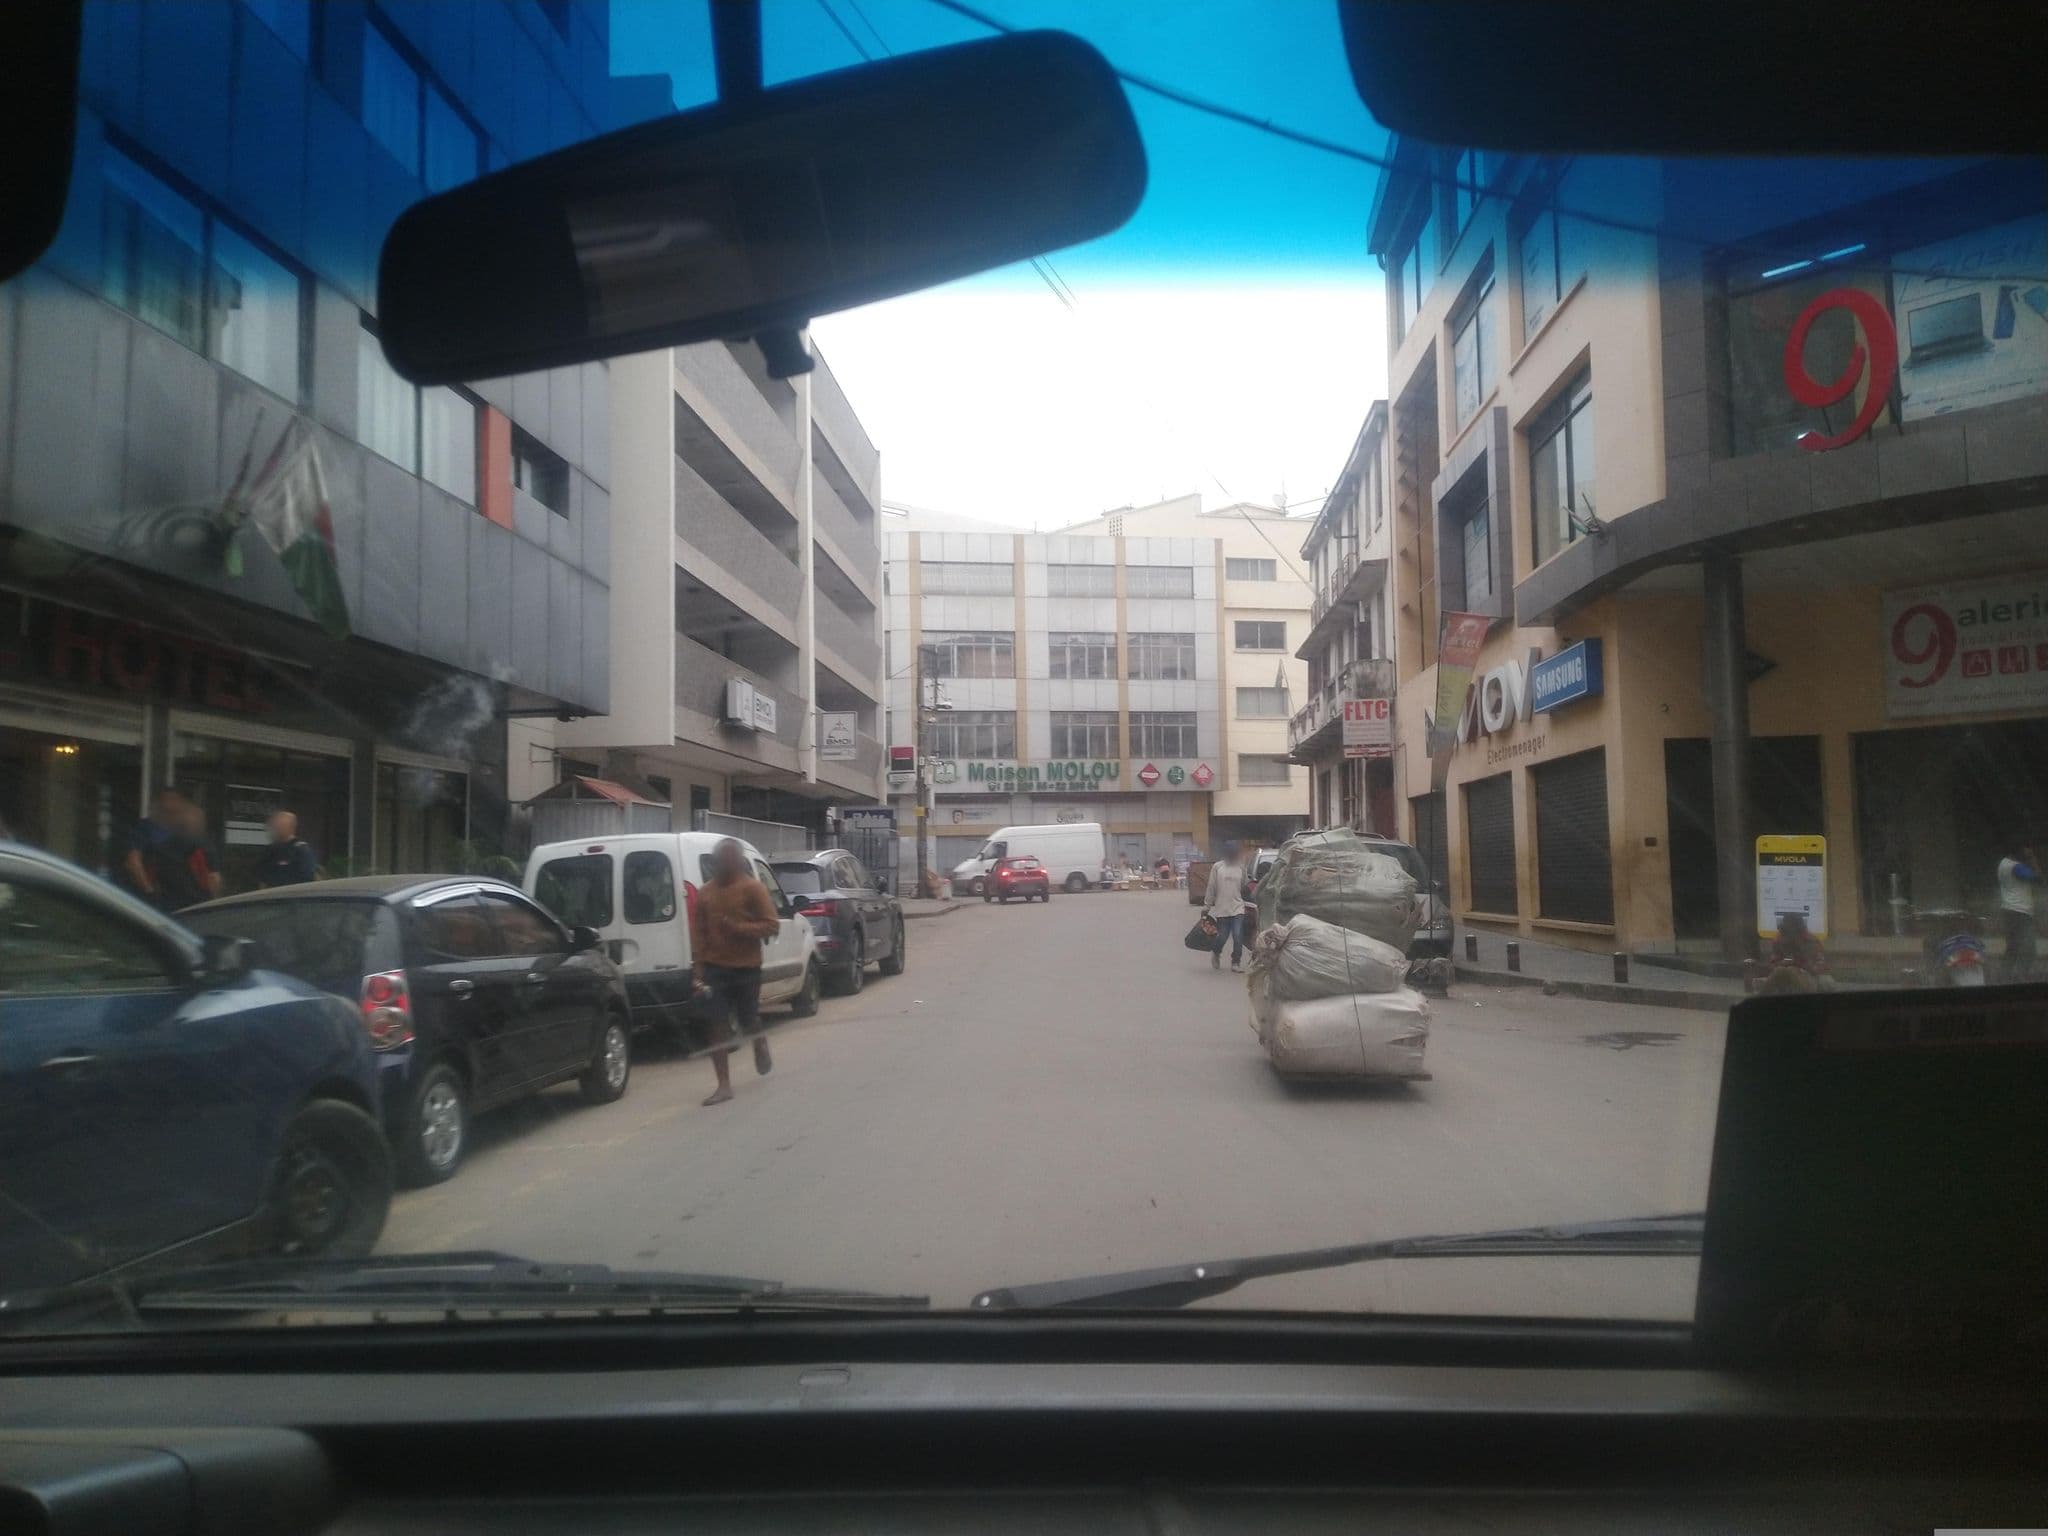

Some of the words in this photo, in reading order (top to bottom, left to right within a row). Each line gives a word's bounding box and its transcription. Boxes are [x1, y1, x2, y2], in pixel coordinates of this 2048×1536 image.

[54, 606, 272, 713] HOTEL
[1535, 656, 1582, 700] SAMSUNG
[1344, 700, 1388, 721] FLTC
[968, 762, 1040, 782] Maison
[1047, 761, 1120, 781] MOLOU
[1774, 856, 1807, 864] MVOLA
